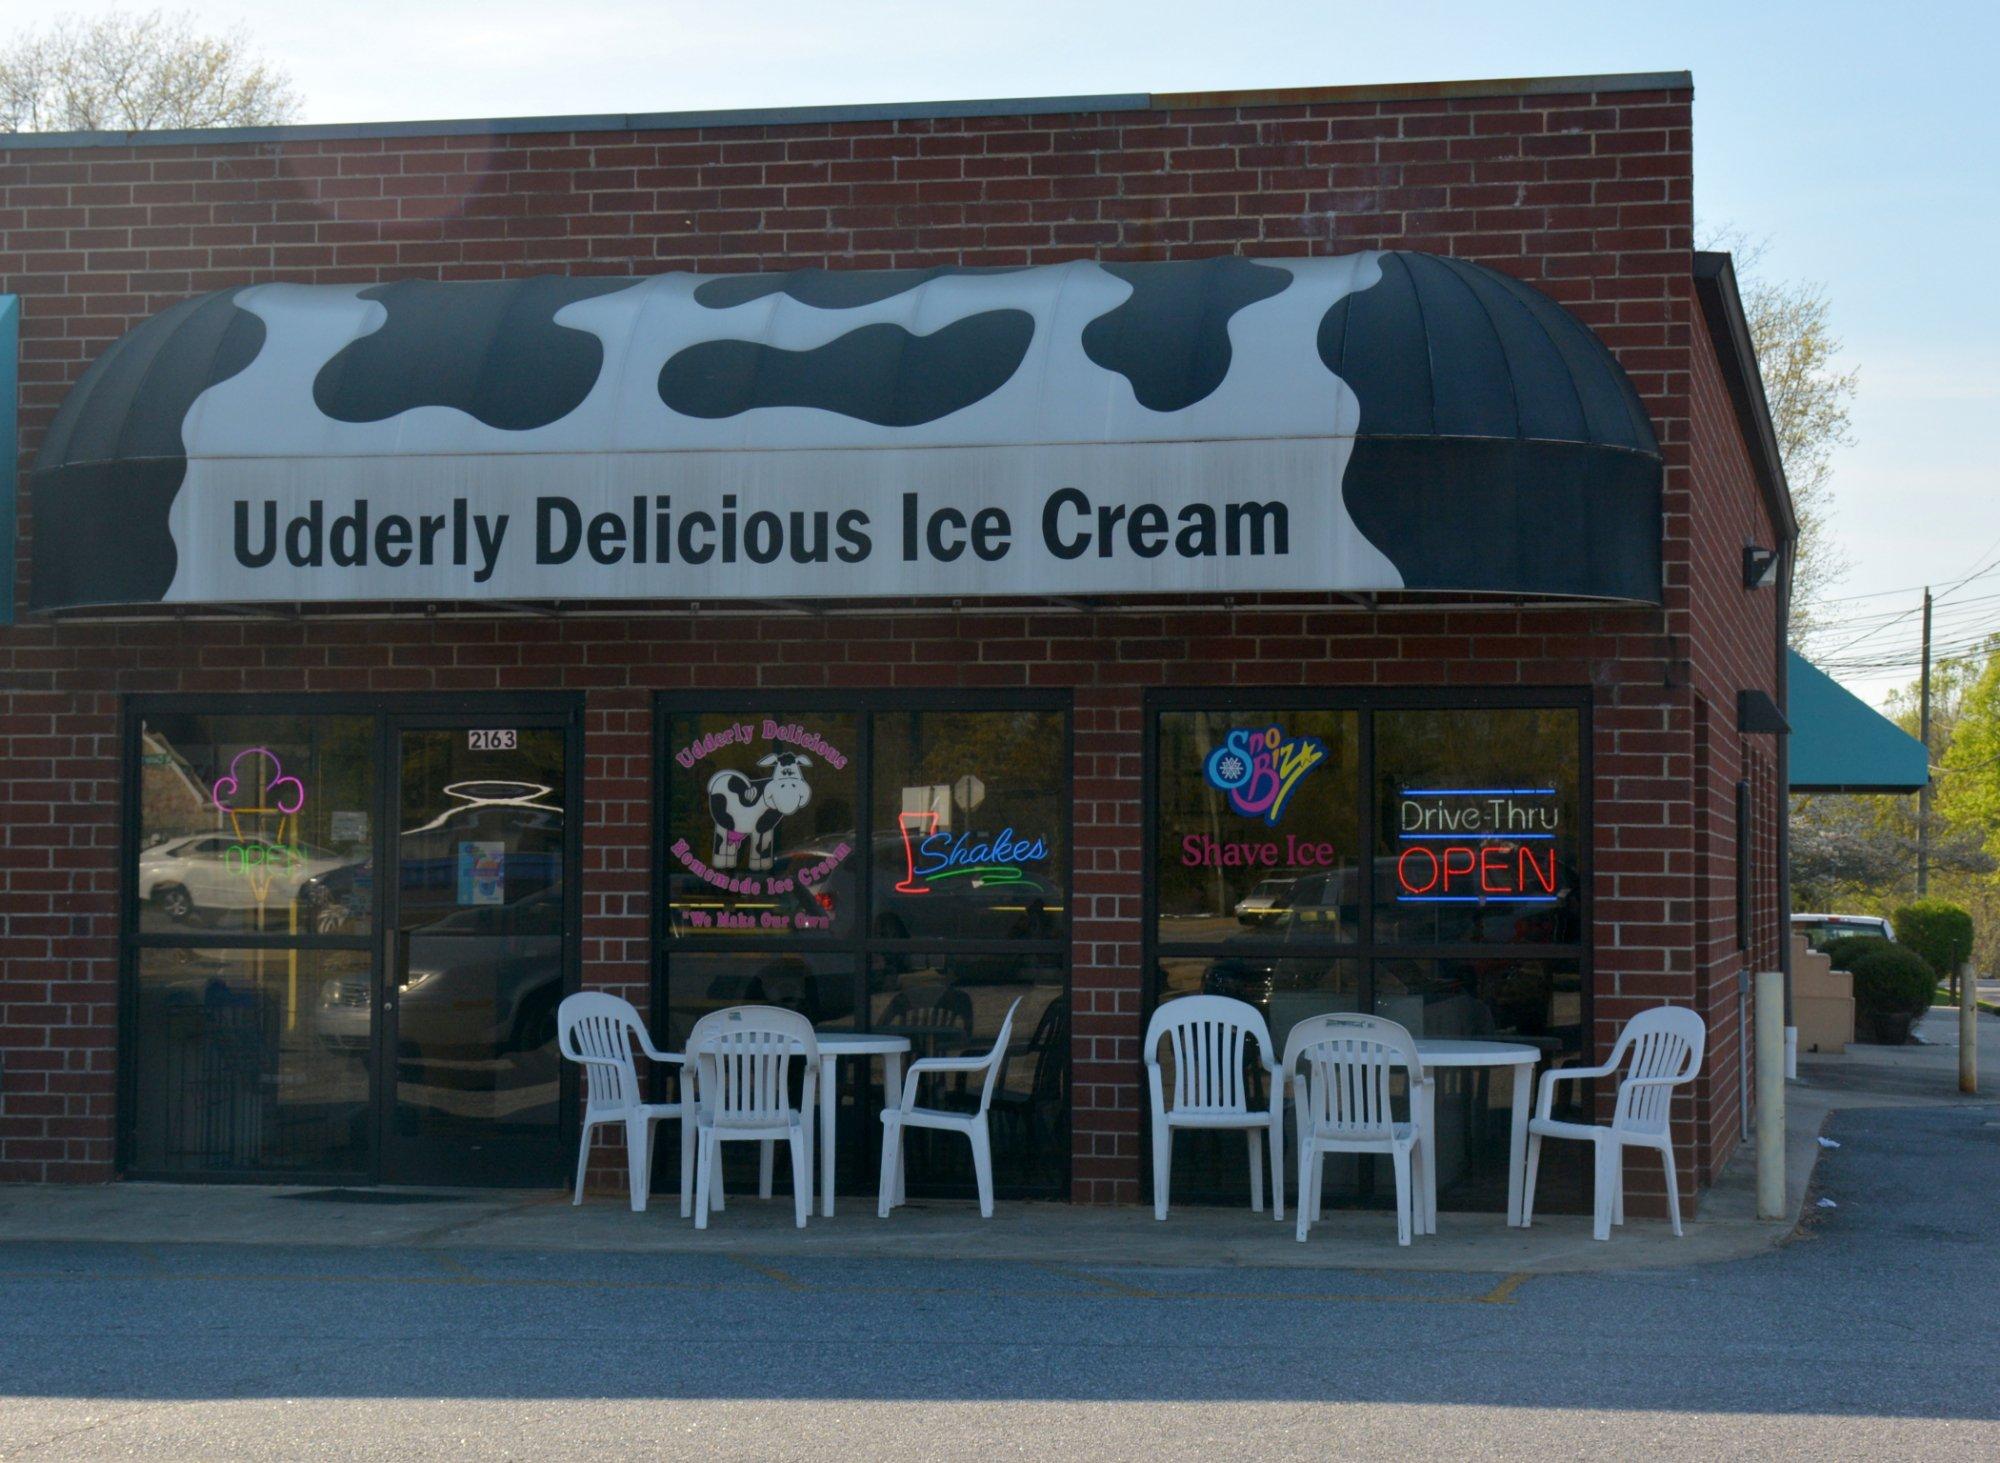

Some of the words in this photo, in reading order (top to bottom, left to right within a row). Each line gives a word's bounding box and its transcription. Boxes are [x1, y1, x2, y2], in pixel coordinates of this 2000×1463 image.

[234, 498, 510, 583] Udderly
[535, 494, 873, 566] Delicious
[902, 492, 1012, 562] Ice
[1042, 487, 1290, 560] Cream
[470, 731, 516, 749] 2163
[675, 722, 755, 769] Udderly
[761, 719, 849, 770] Delicious
[1401, 799, 1559, 830] Drive-Thru
[223, 844, 308, 877] OPEN
[670, 838, 761, 895] Homemade
[766, 877, 794, 895] Ice
[797, 842, 853, 886] Cream
[914, 828, 1048, 875] Shakes
[1181, 834, 1279, 867] Shave
[1287, 834, 1335, 867] Ice
[1397, 847, 1556, 893] OPEN
[682, 911, 712, 928] "We
[716, 911, 756, 929] Make
[760, 911, 790, 929] Our
